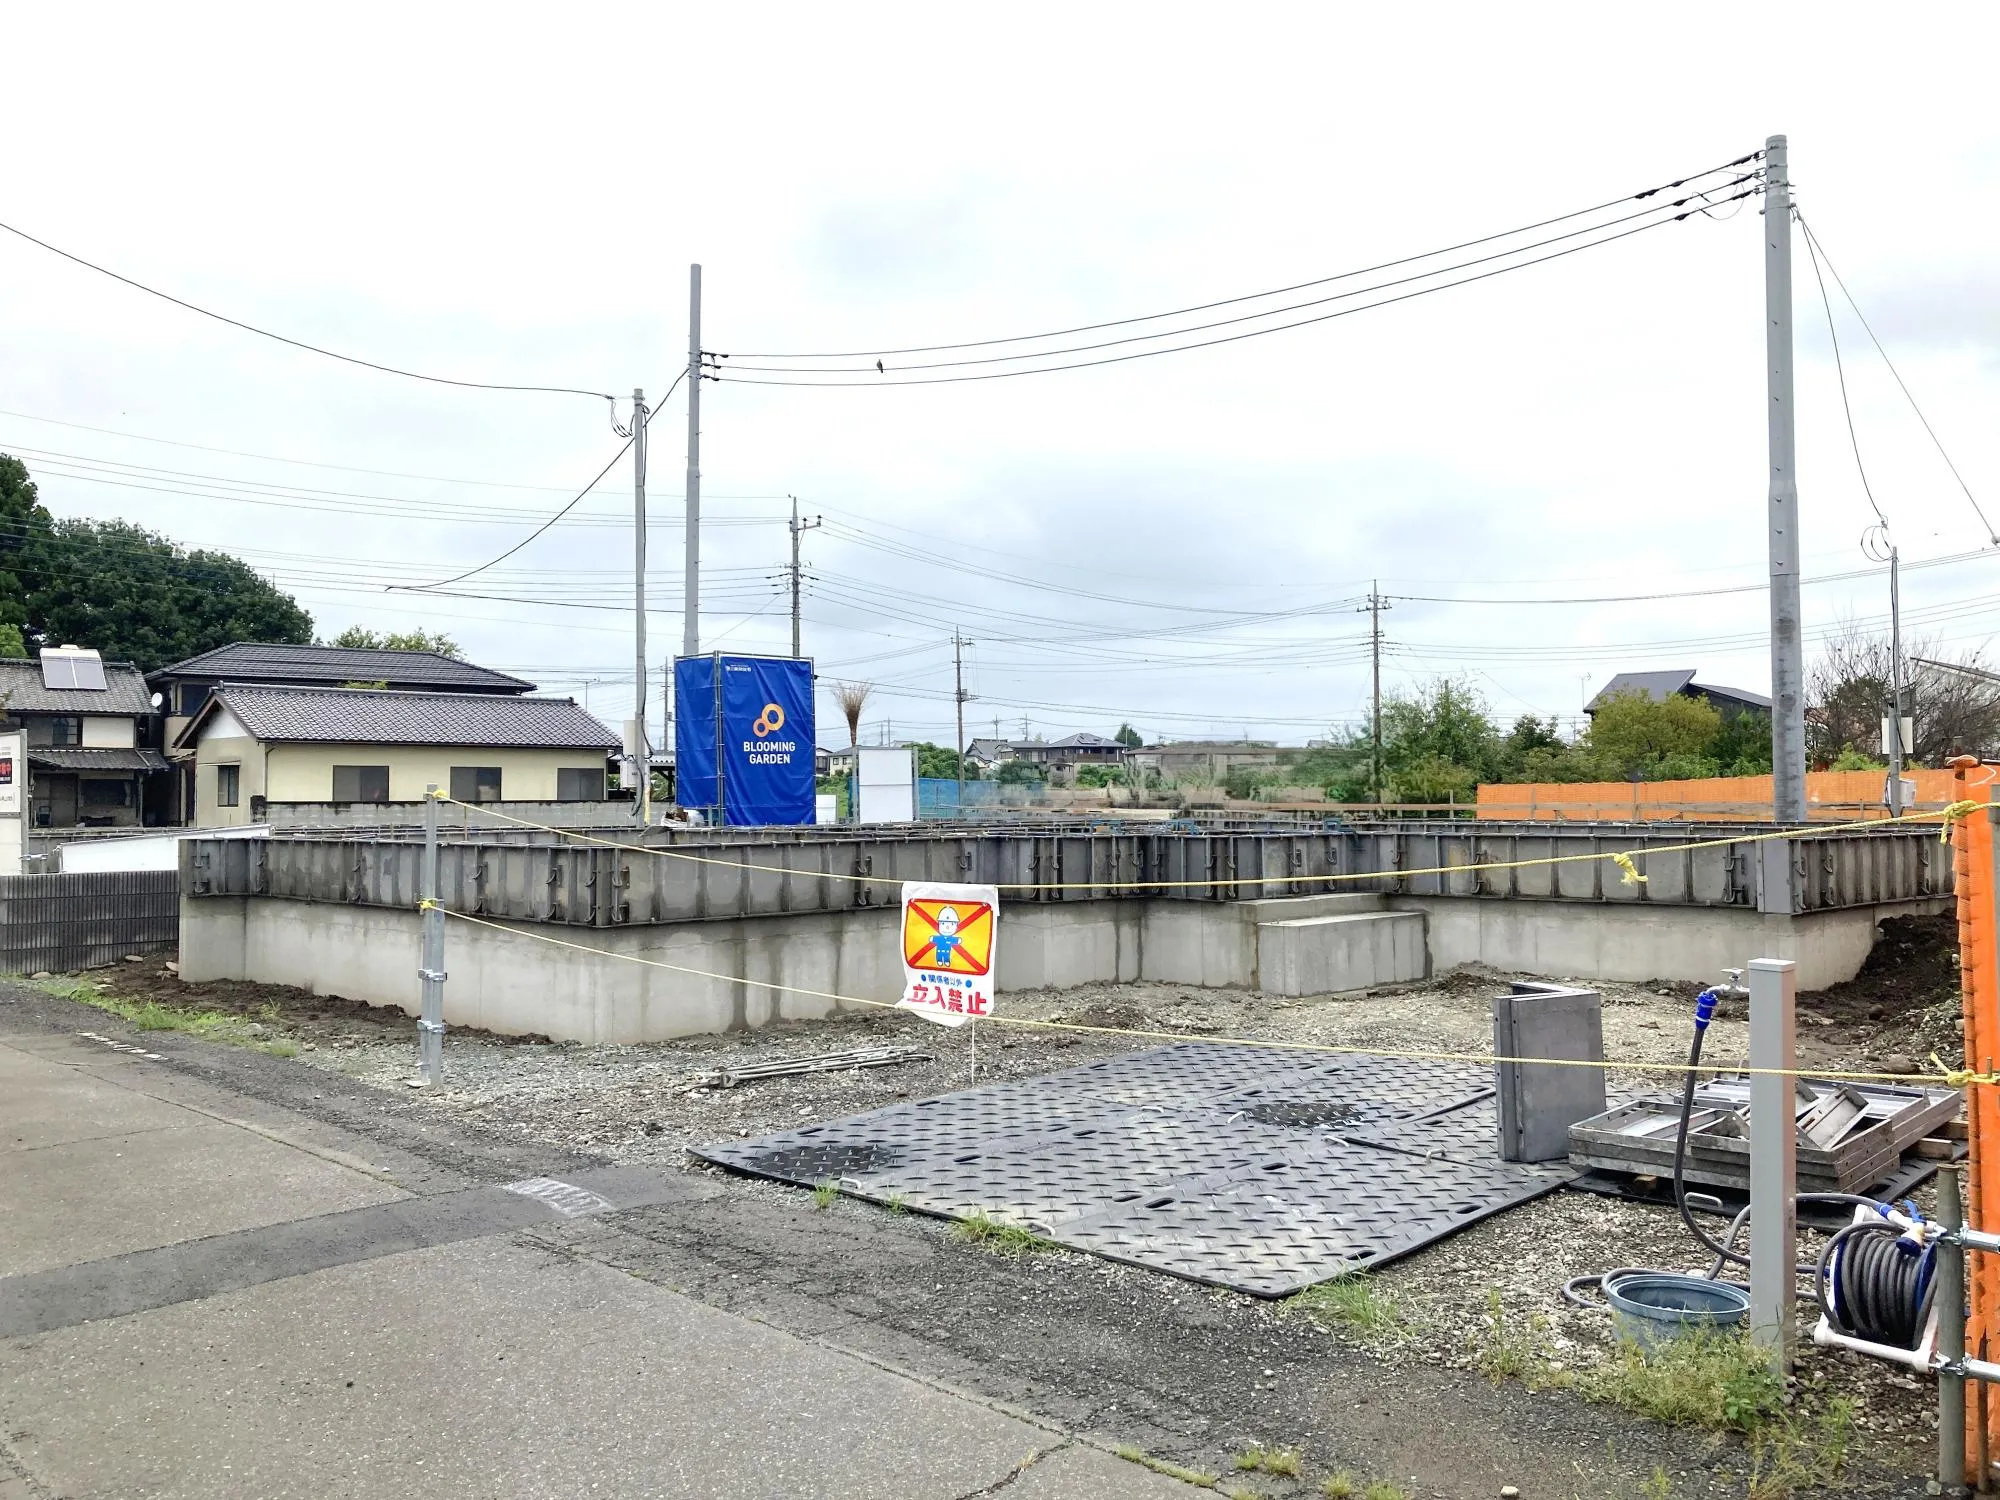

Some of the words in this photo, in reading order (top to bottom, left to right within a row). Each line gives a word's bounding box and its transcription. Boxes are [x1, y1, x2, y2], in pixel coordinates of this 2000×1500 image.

[743, 741, 796, 752] BLOOMING
[749, 753, 791, 764] GARDEN
[907, 983, 987, 1015] 立入禁止
